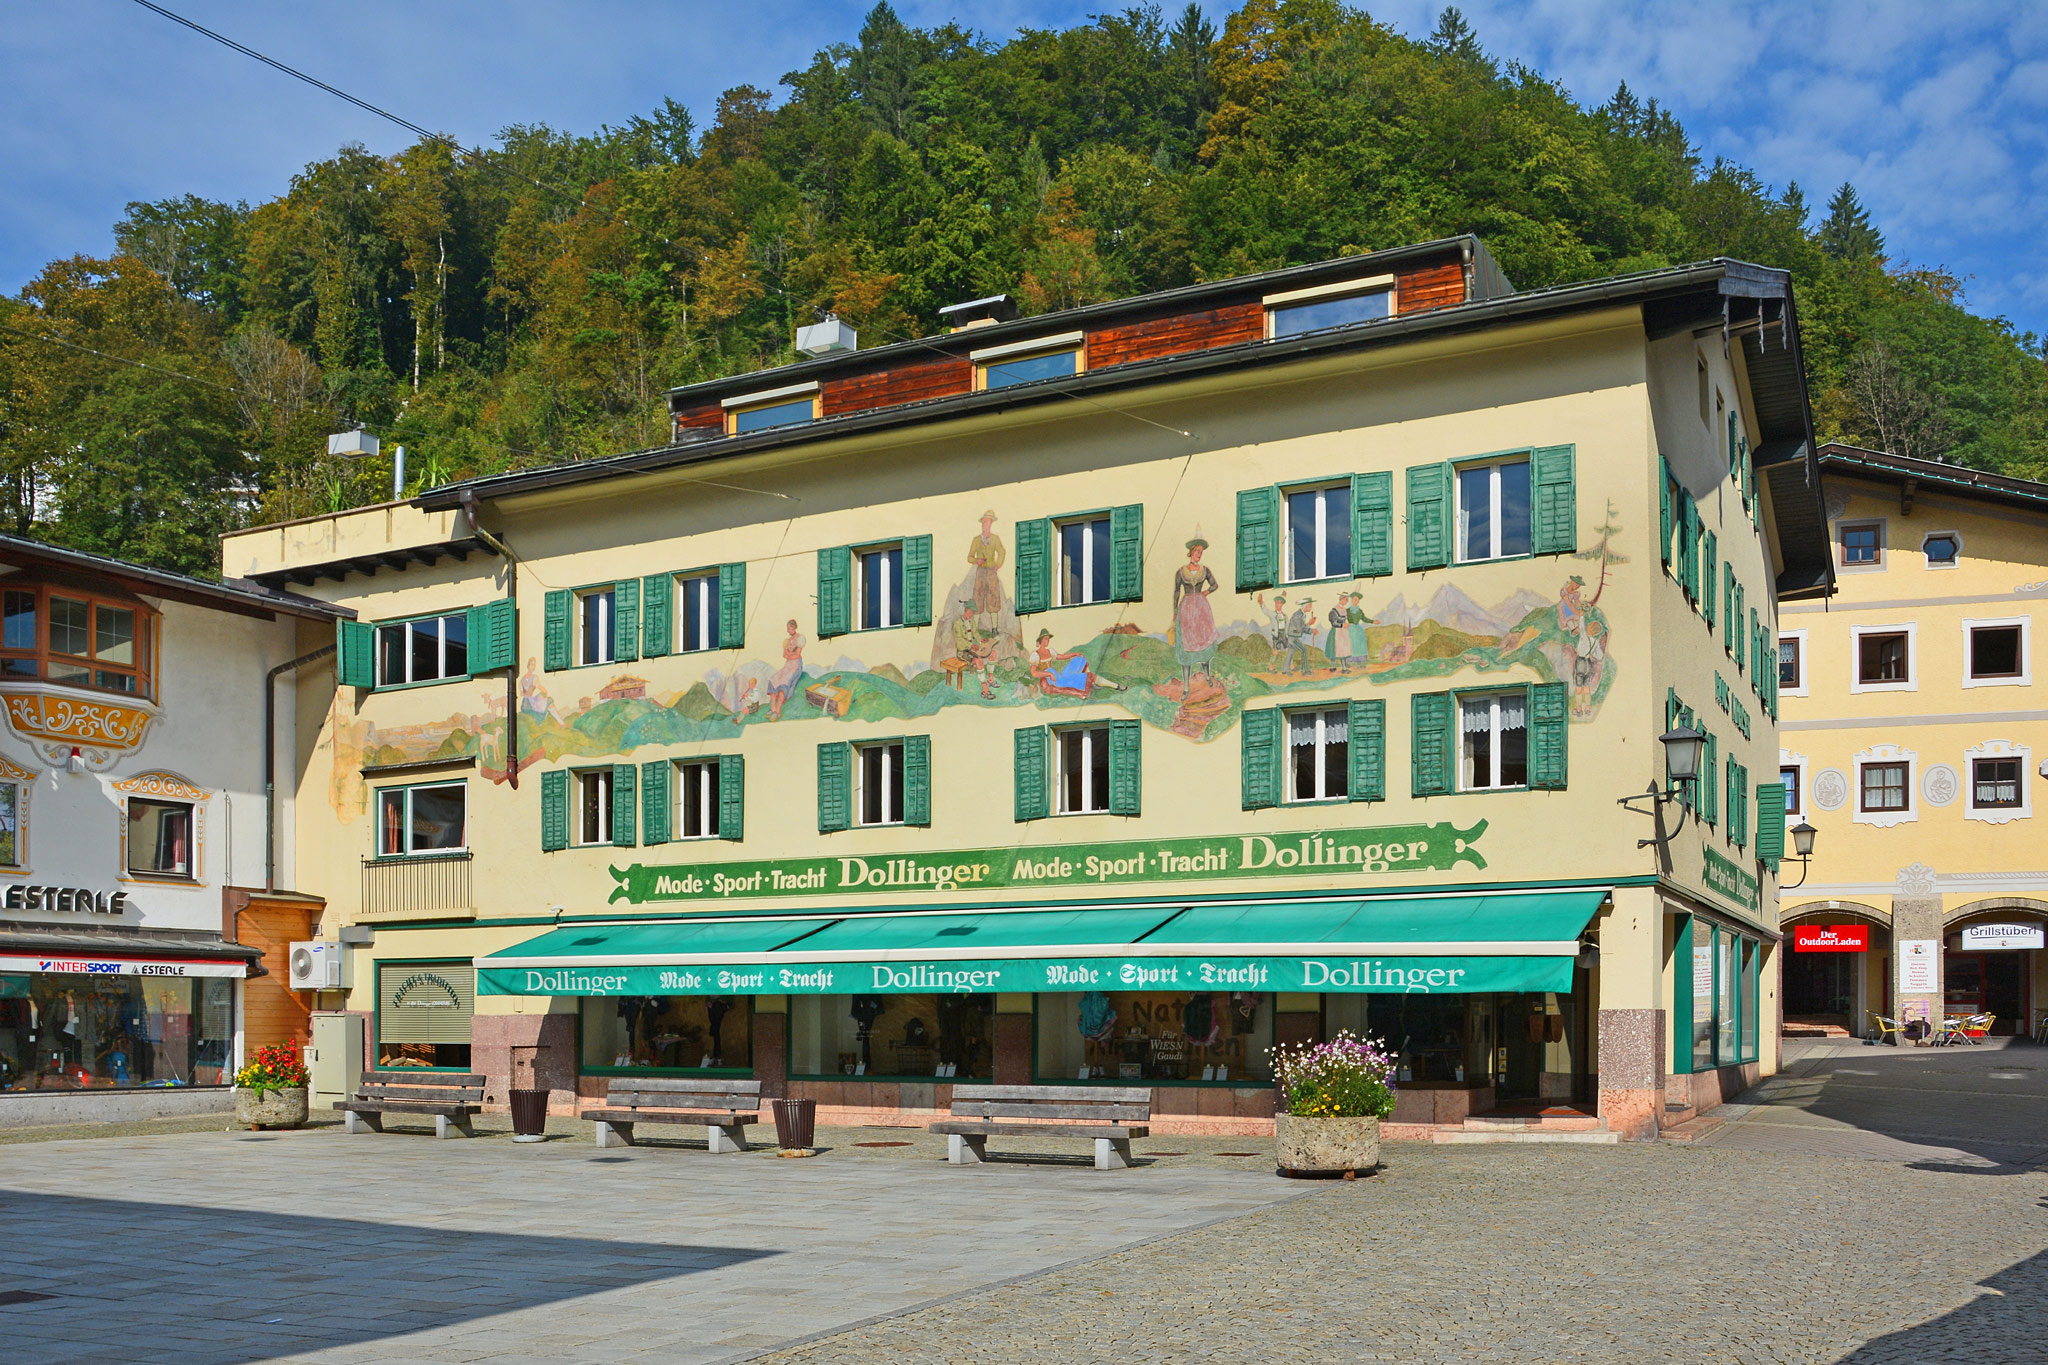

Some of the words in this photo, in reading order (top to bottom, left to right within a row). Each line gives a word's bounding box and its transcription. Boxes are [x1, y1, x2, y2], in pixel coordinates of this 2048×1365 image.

[1012, 857, 1072, 880] Mode
[1085, 852, 1146, 881] Sport
[1158, 847, 1229, 873] Tracht
[1237, 835, 1429, 873] Dollinger
[654, 874, 703, 894] Mode
[713, 870, 762, 897] Sport
[771, 867, 827, 889] Tracht
[837, 857, 990, 891] Dollinger
[4, 884, 129, 915] ESTERLE
[1799, 937, 1862, 946] OutdoorLaden
[1820, 931, 1838, 939] Der
[1969, 926, 2037, 936] Grillstüberl
[53, 961, 122, 973] INTERSPORT
[142, 965, 185, 975] ESTERLE
[871, 965, 1001, 993] Dollinger
[1046, 965, 1099, 985] Mode
[1119, 963, 1179, 989] Sport
[1199, 962, 1269, 989] Tracht
[1301, 960, 1466, 993] Dollinger
[525, 970, 628, 996] Dollinger
[660, 971, 702, 989] Mode
[717, 970, 763, 993] Sport
[778, 969, 833, 992] Tracht
[1133, 998, 1185, 1022] Nat
[1161, 1030, 1178, 1039] Für
[1156, 1051, 1184, 1061] Gaudi
